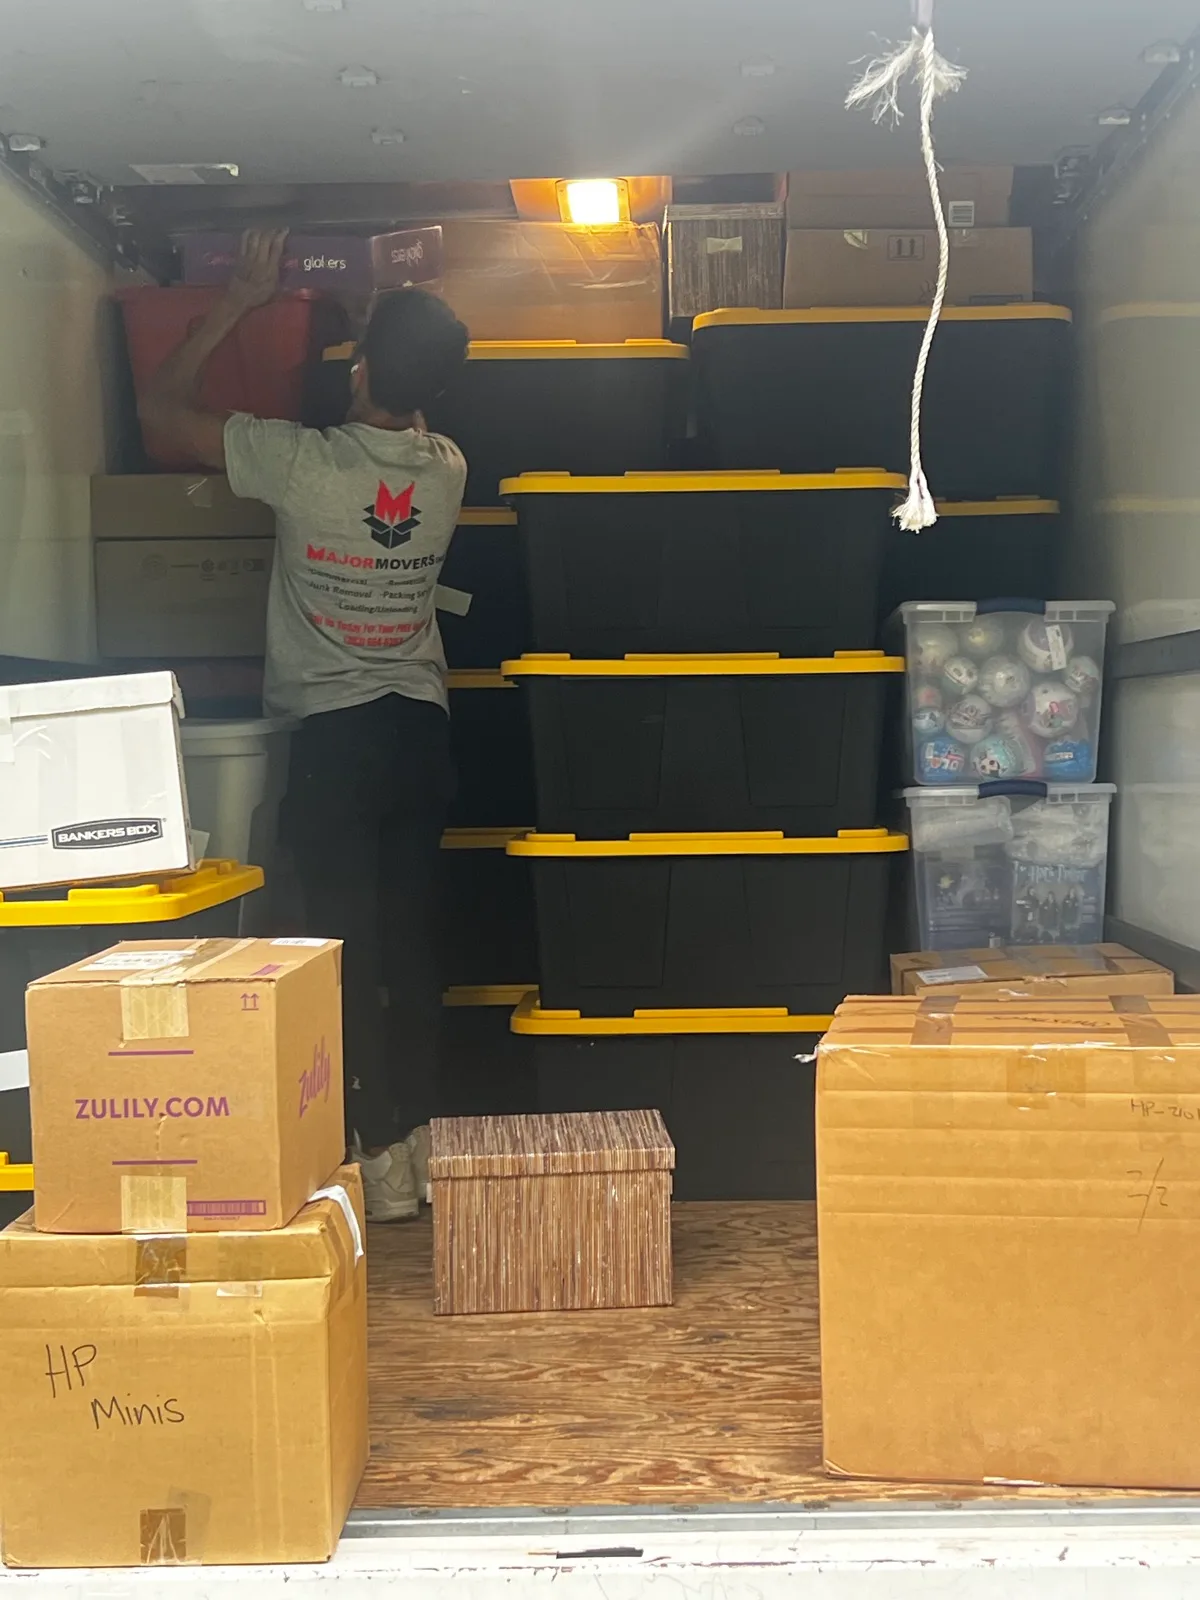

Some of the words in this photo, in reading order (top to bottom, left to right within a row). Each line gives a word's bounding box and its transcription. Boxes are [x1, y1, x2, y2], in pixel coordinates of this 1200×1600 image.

[333, 585, 372, 599] Removal
[58, 829, 126, 843] BANKERS
[126, 824, 157, 836] BOX
[75, 1096, 230, 1119] ZULILY.COM
[45, 1344, 97, 1398] HP
[90, 1392, 185, 1430] Minis
